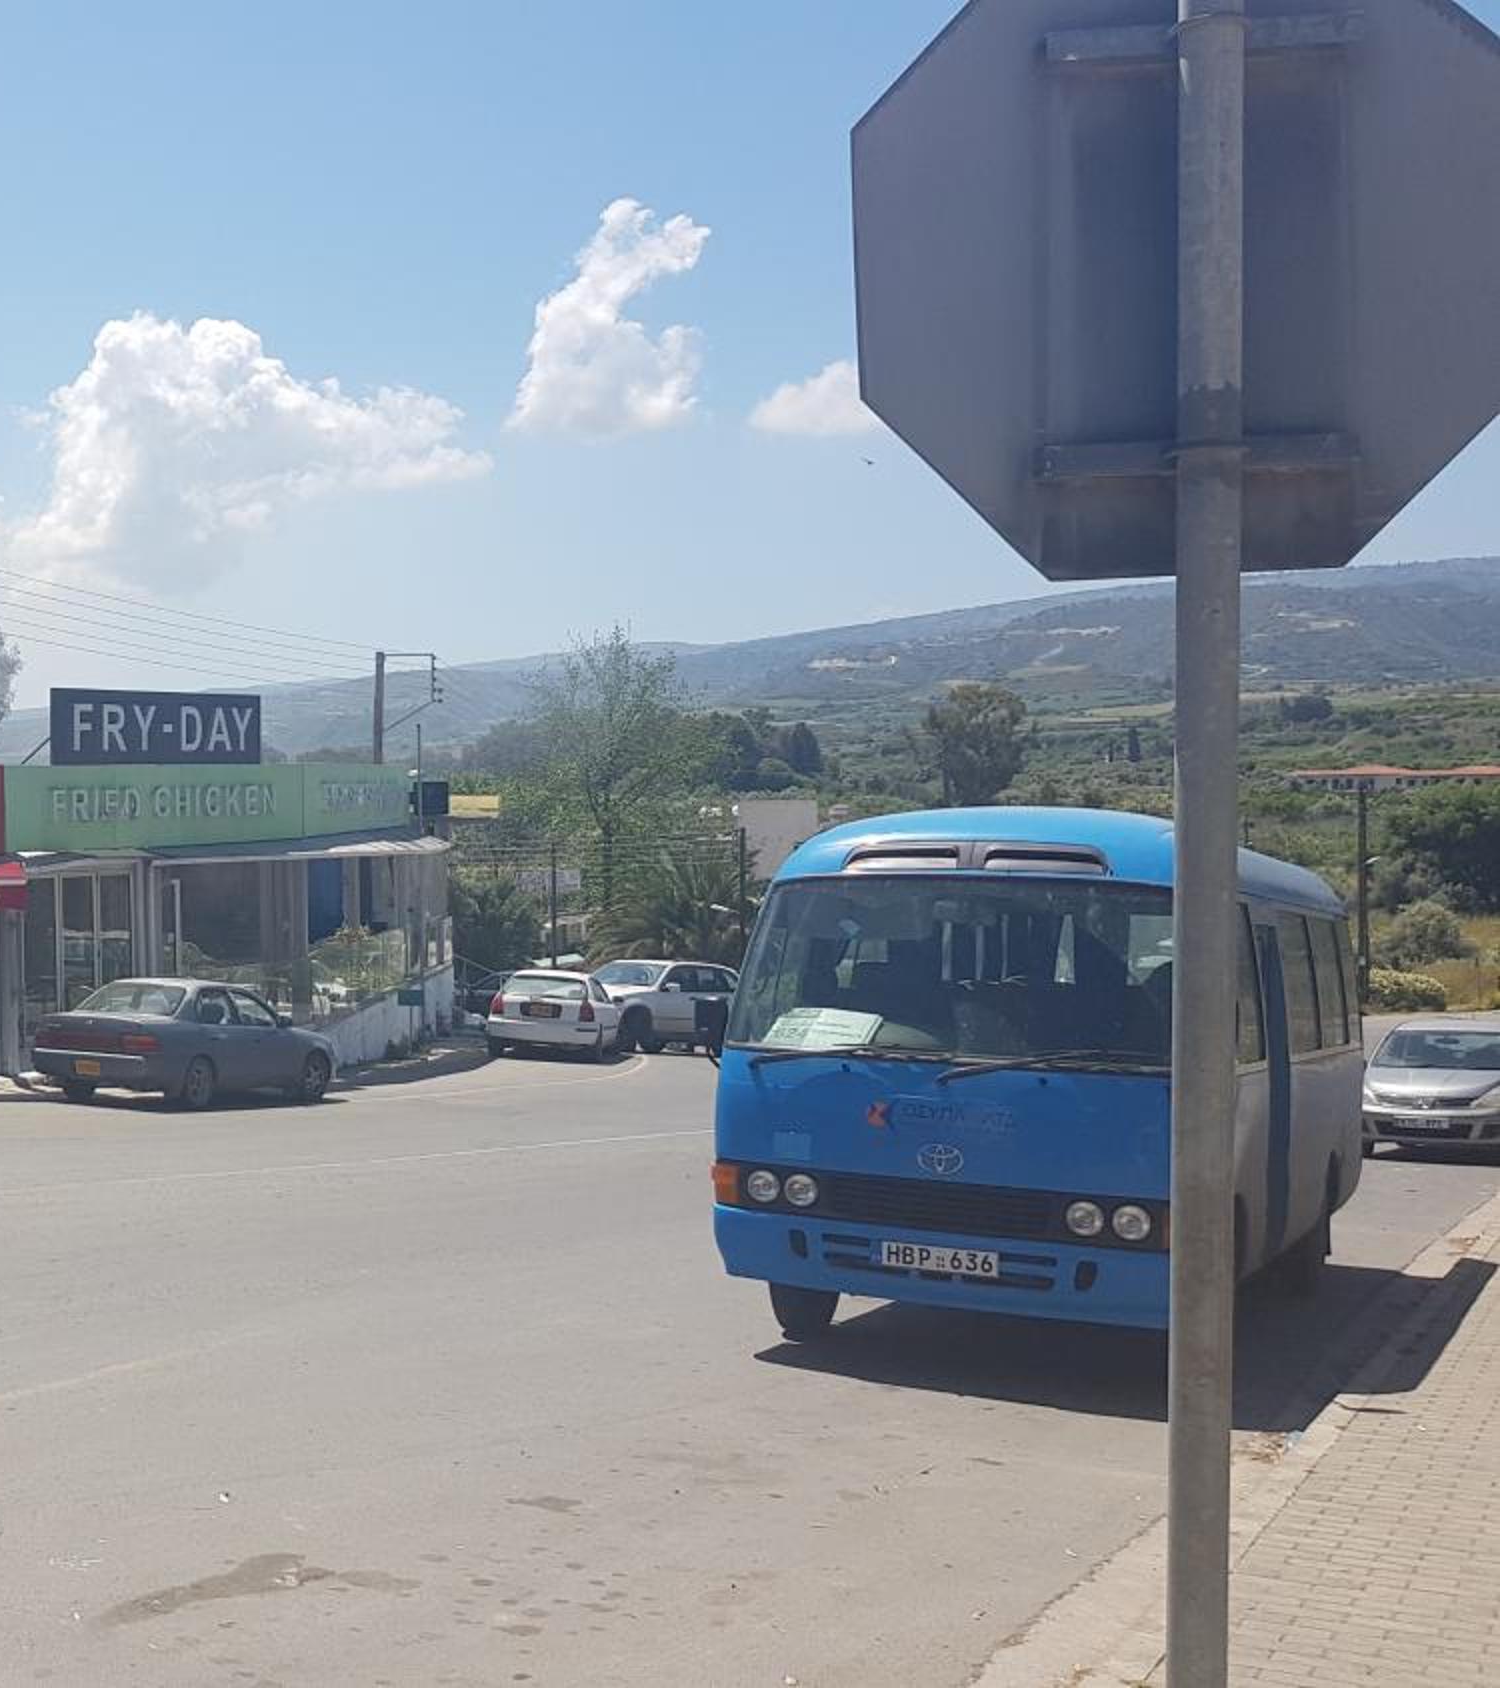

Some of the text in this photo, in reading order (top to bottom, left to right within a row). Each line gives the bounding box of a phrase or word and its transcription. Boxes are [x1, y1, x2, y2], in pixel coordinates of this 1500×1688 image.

[73, 703, 252, 752] FRY-DAY
[52, 785, 276, 820] FRIED CHICKEN
[886, 1244, 993, 1273] HBP 636
